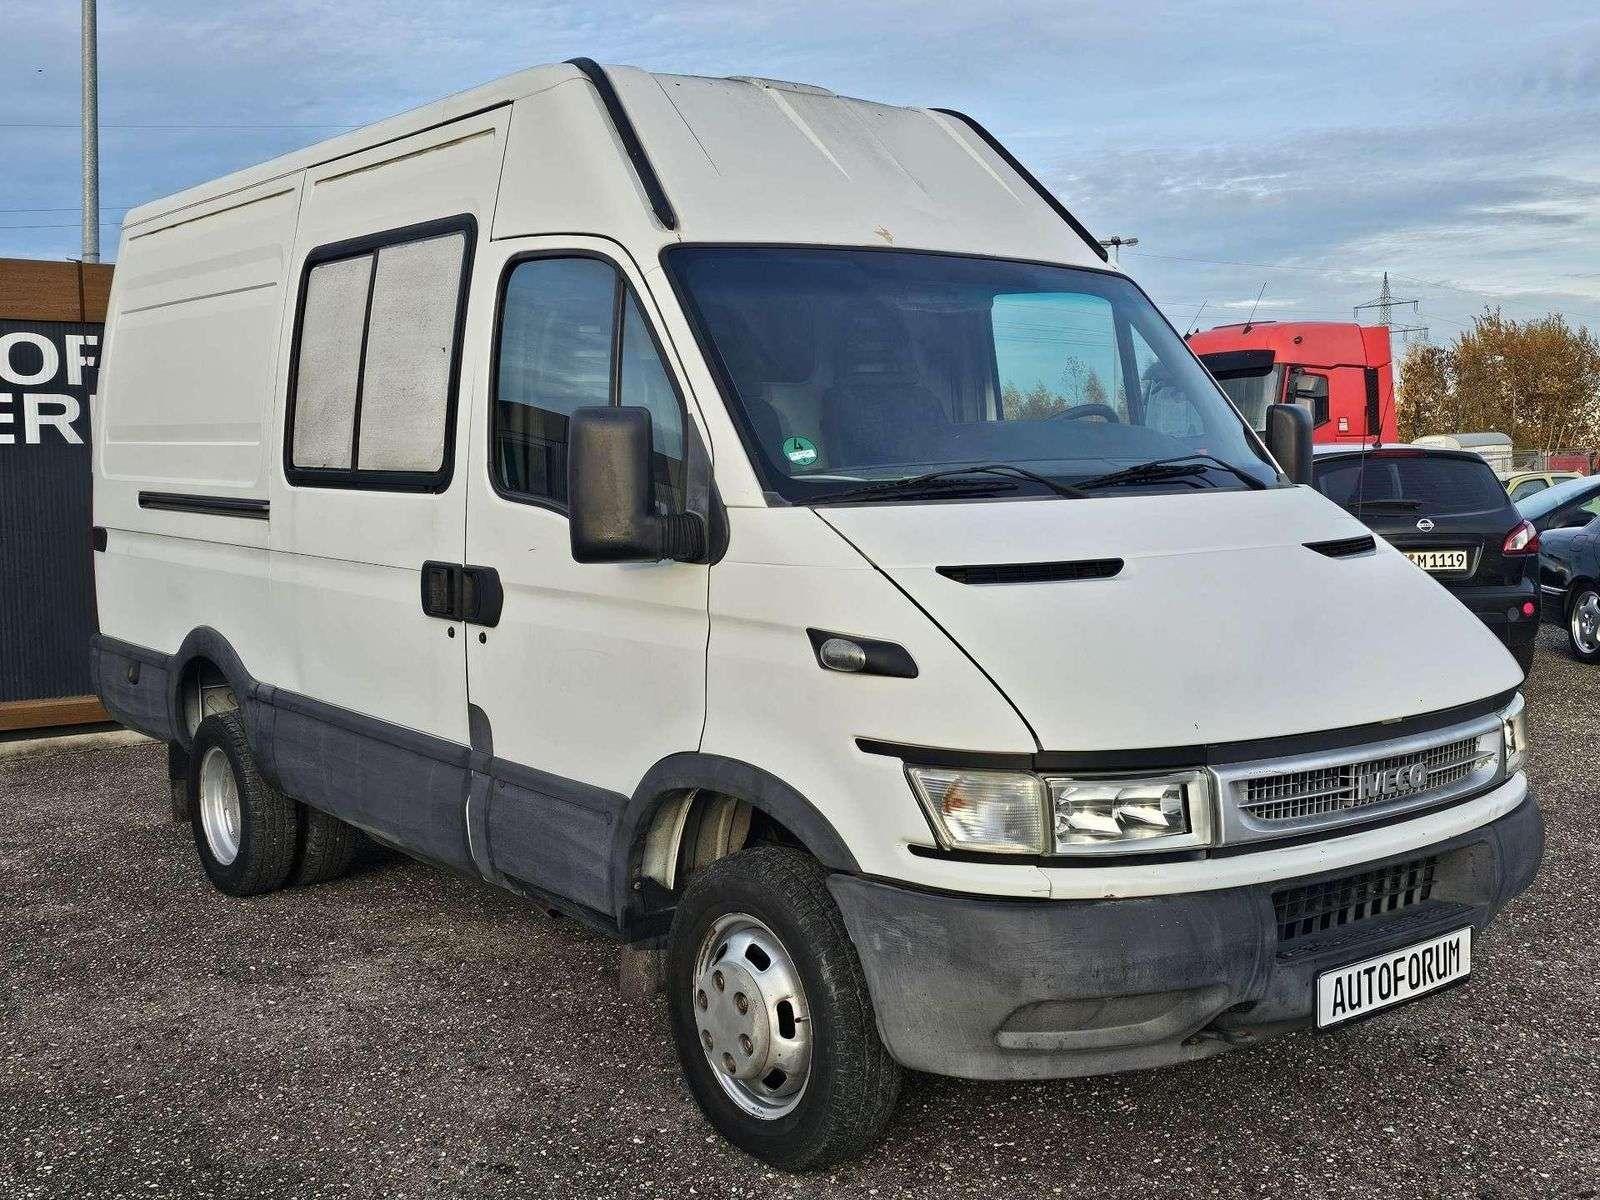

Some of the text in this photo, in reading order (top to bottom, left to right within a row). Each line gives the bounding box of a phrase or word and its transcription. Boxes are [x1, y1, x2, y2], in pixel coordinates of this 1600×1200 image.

[1429, 553, 1465, 568] 1119
[1357, 762, 1427, 801] IVECO
[1332, 937, 1460, 1017] AUTOFORUM
